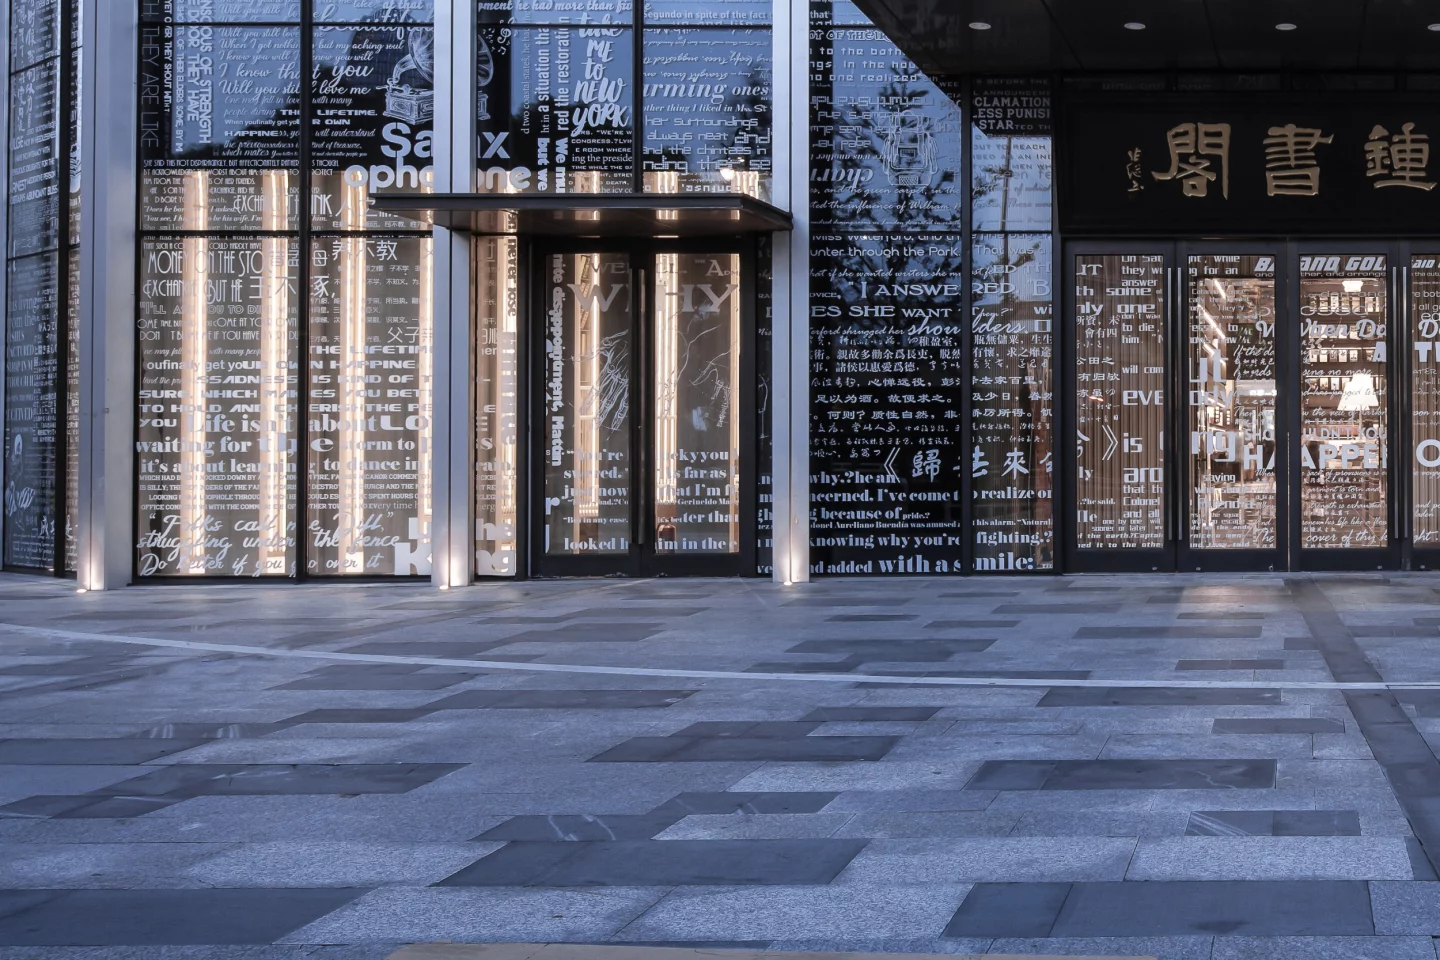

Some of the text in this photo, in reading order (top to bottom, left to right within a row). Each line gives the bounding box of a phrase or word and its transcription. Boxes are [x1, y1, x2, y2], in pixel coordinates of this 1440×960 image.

[352, 41, 384, 52] aching
[237, 64, 272, 78] know
[329, 64, 373, 87] you
[219, 80, 253, 95] Will
[849, 246, 924, 257] through the
[857, 268, 892, 277] wanted
[849, 305, 895, 317] SHE
[140, 419, 176, 428] YOU
[220, 436, 251, 452] for
[398, 438, 415, 451] to
[909, 489, 950, 501] come
[981, 487, 1034, 500] realize
[822, 508, 881, 519] because
[878, 534, 910, 548] why
[827, 555, 929, 572] added with
